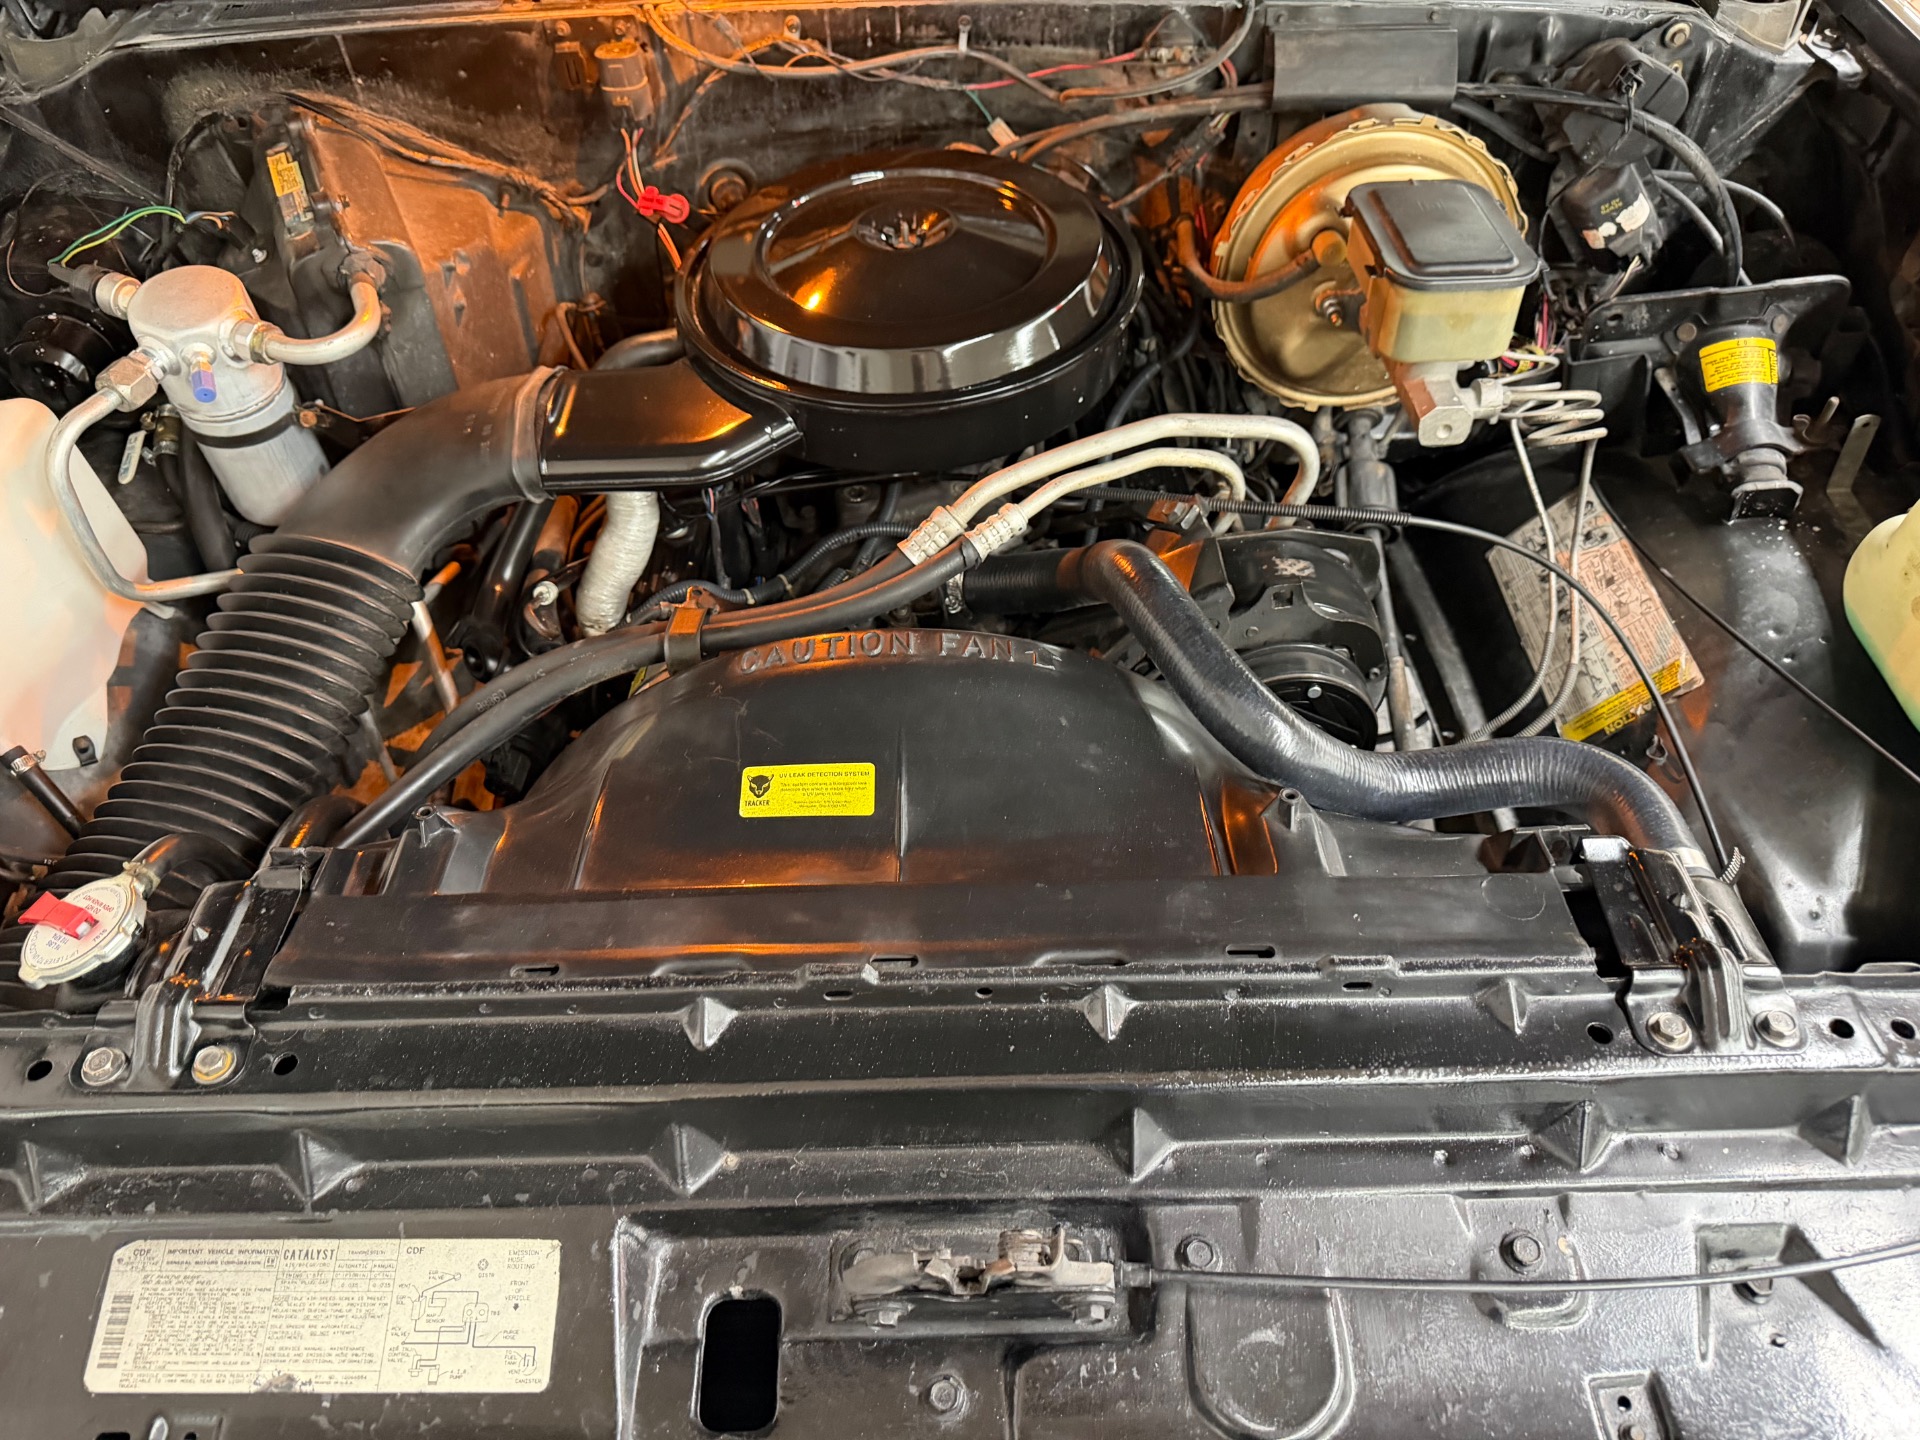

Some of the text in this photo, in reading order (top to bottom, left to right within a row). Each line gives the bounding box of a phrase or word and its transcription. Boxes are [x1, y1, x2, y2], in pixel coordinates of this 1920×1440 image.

[740, 631, 1015, 675] CAUTION FAN
[283, 1248, 336, 1260] CATALYST
[406, 1246, 425, 1255] CDF
